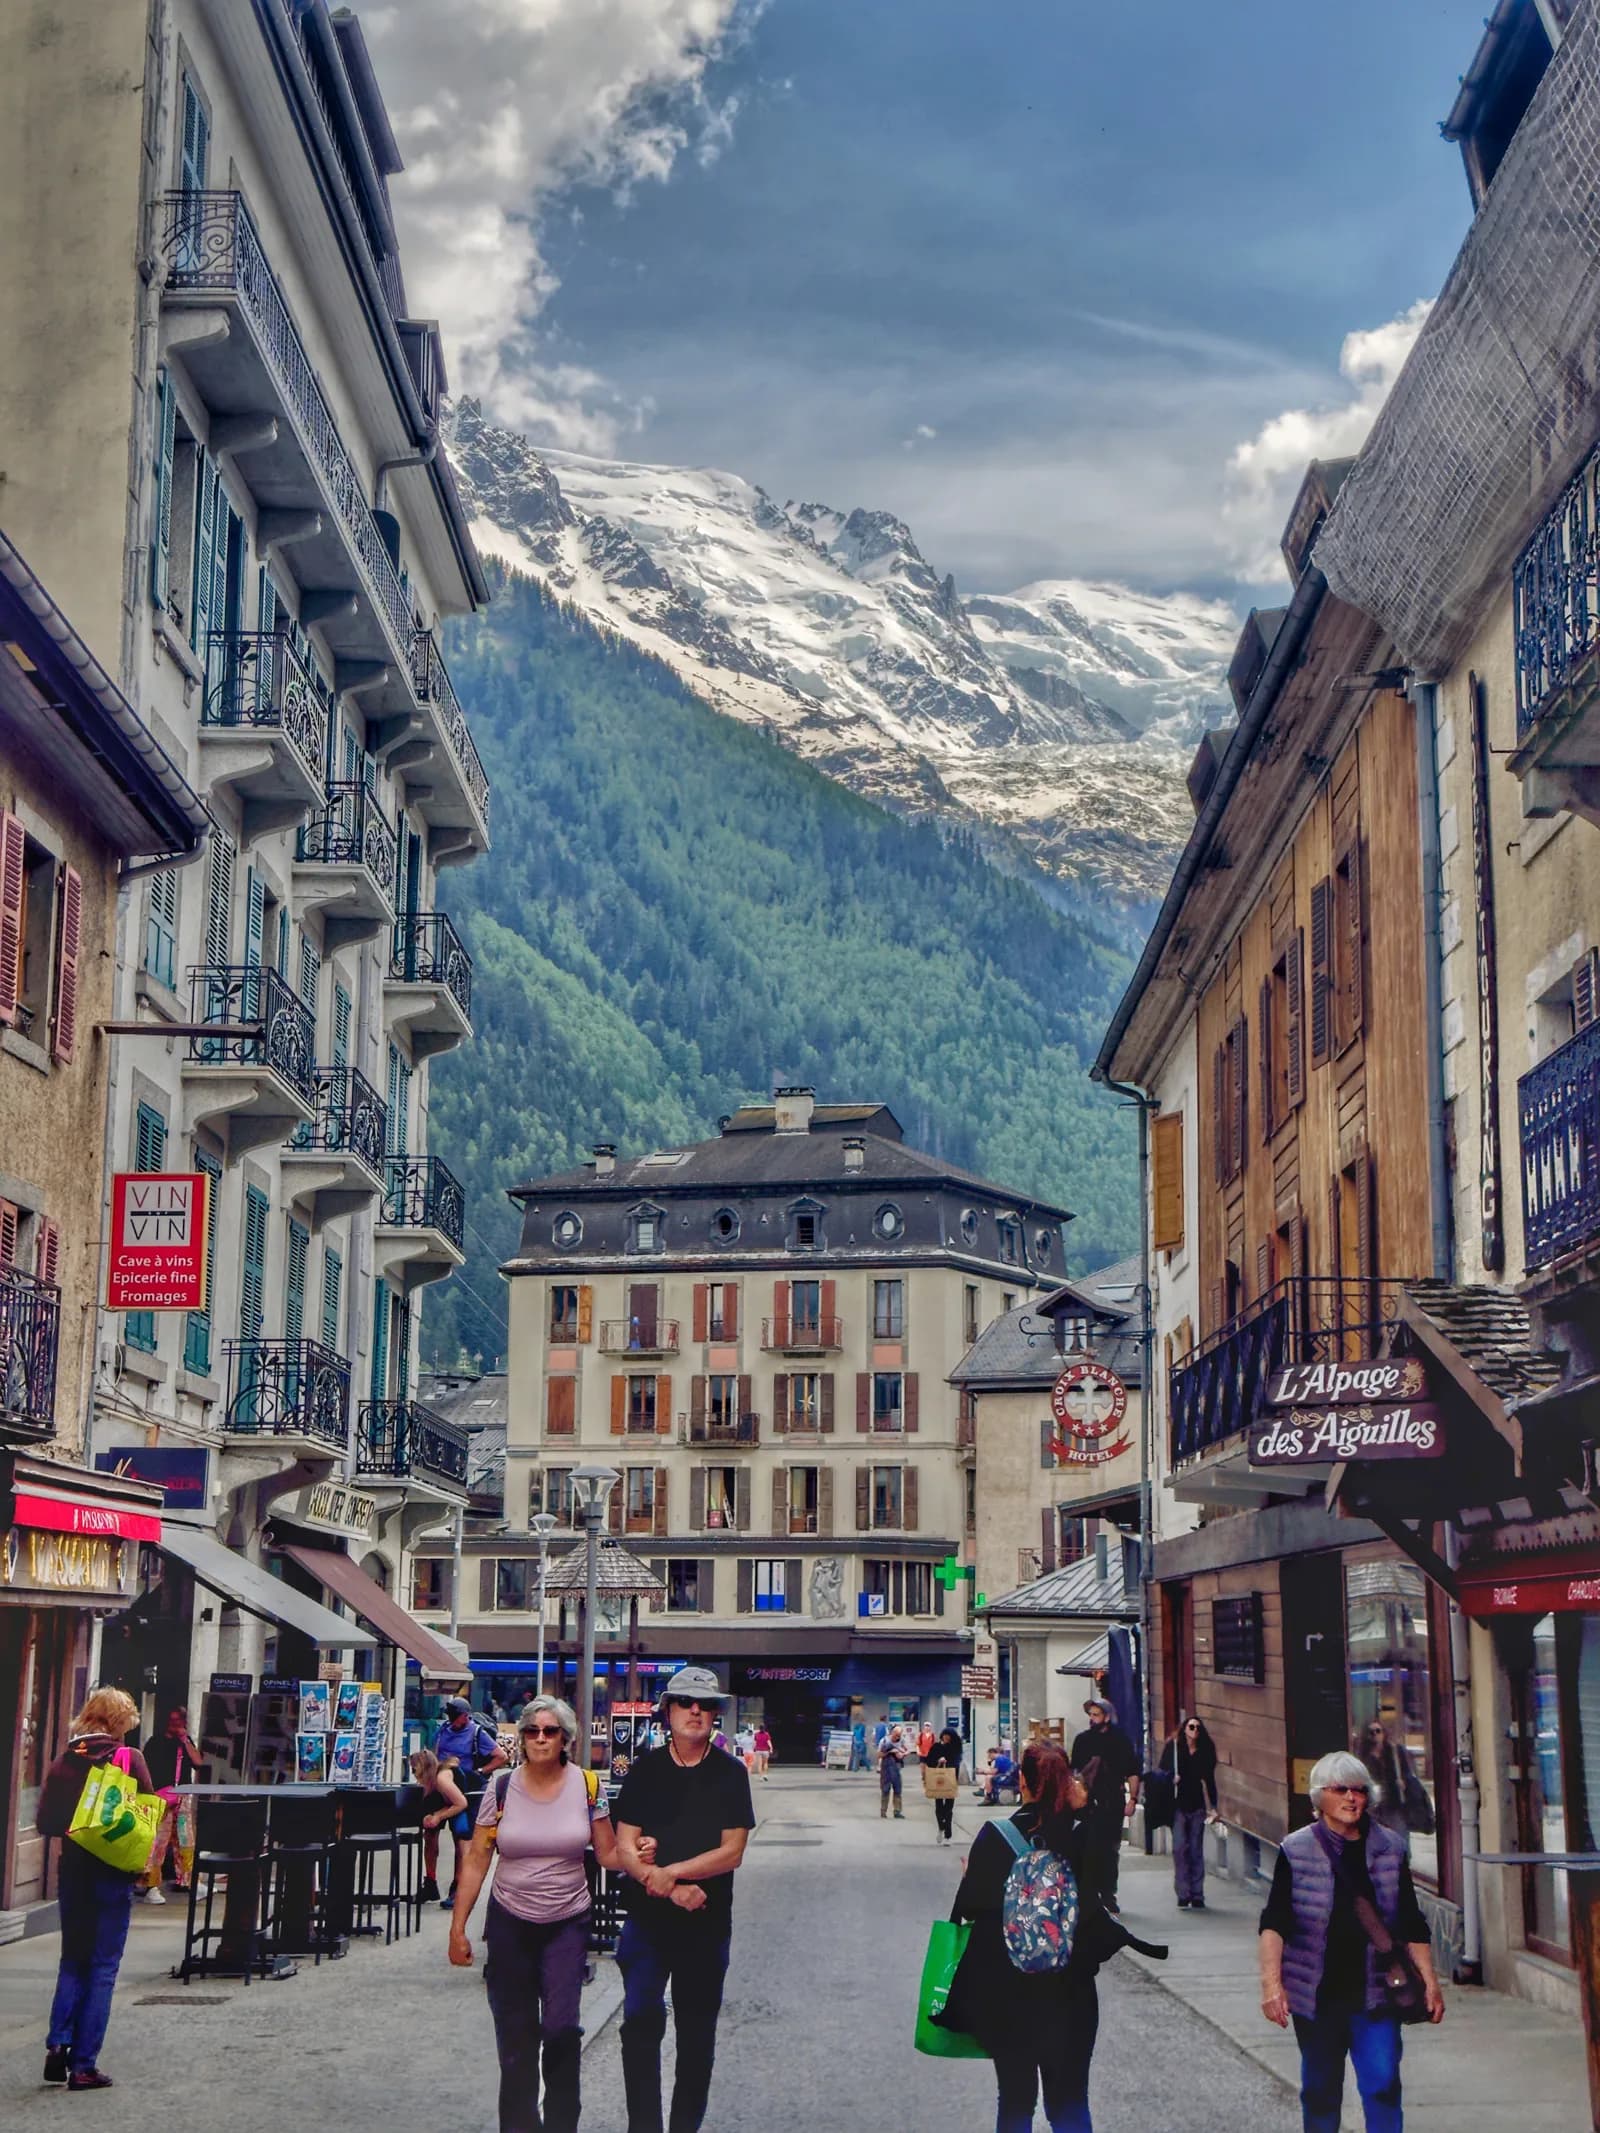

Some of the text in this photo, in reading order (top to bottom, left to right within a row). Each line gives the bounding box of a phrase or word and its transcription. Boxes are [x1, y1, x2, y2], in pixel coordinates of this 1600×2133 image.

[132, 1186, 187, 1209] VIN
[130, 1218, 186, 1241] VIN
[118, 1254, 194, 1267] Cave à vins
[113, 1271, 198, 1286] Epicerie fine
[120, 1290, 188, 1305] Fromages
[1054, 1365, 1125, 1418] CROIX BLANCHE
[1274, 1363, 1400, 1402] L'Alpage
[1257, 1408, 1437, 1457] des Aiguilles
[1067, 1449, 1114, 1463] HOTEL
[761, 1667, 831, 1681] INTERSPORT
